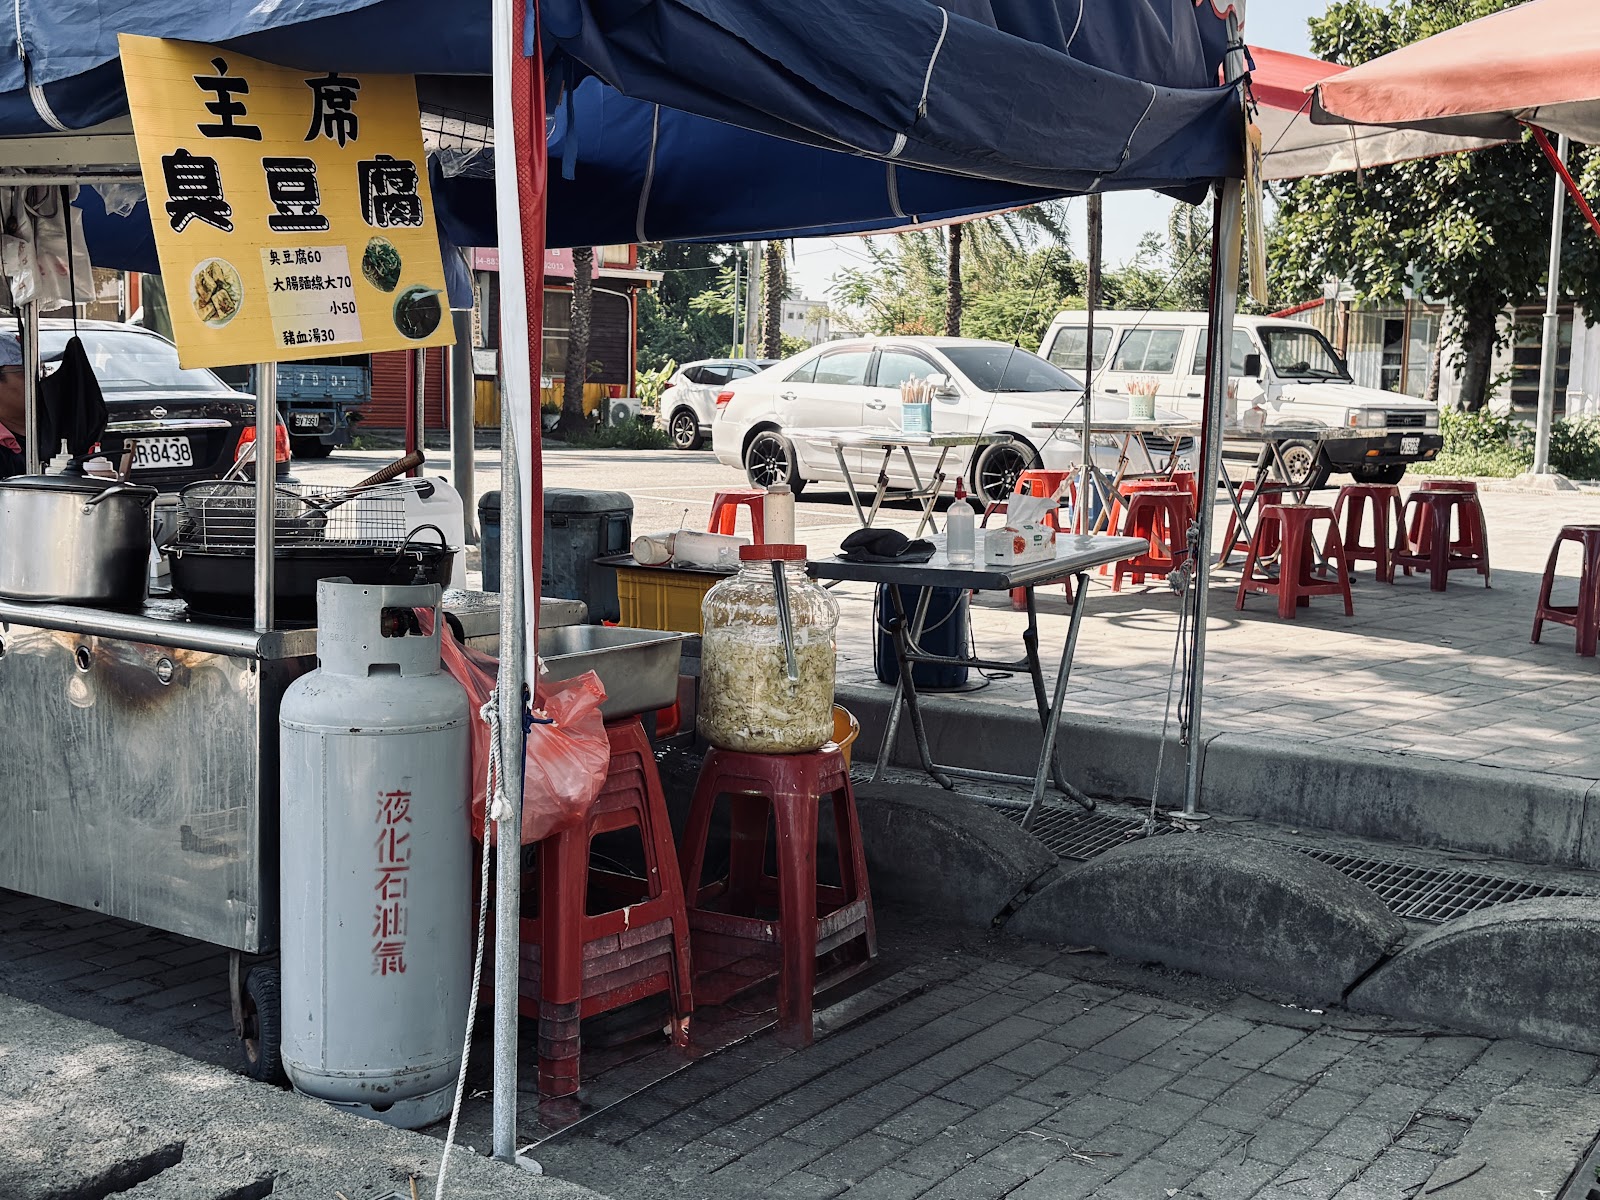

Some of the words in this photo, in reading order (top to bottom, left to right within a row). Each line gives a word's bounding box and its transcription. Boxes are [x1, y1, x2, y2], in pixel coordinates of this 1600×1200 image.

[193, 57, 361, 149] 主席
[161, 148, 423, 233] 臭豆腐
[269, 248, 322, 266] 臭豆腐60
[273, 275, 352, 292] 大腸麵線大70
[330, 300, 356, 315] 小50
[282, 328, 335, 345] 豬血湯30
[371, 789, 412, 976] 液化石油氣
